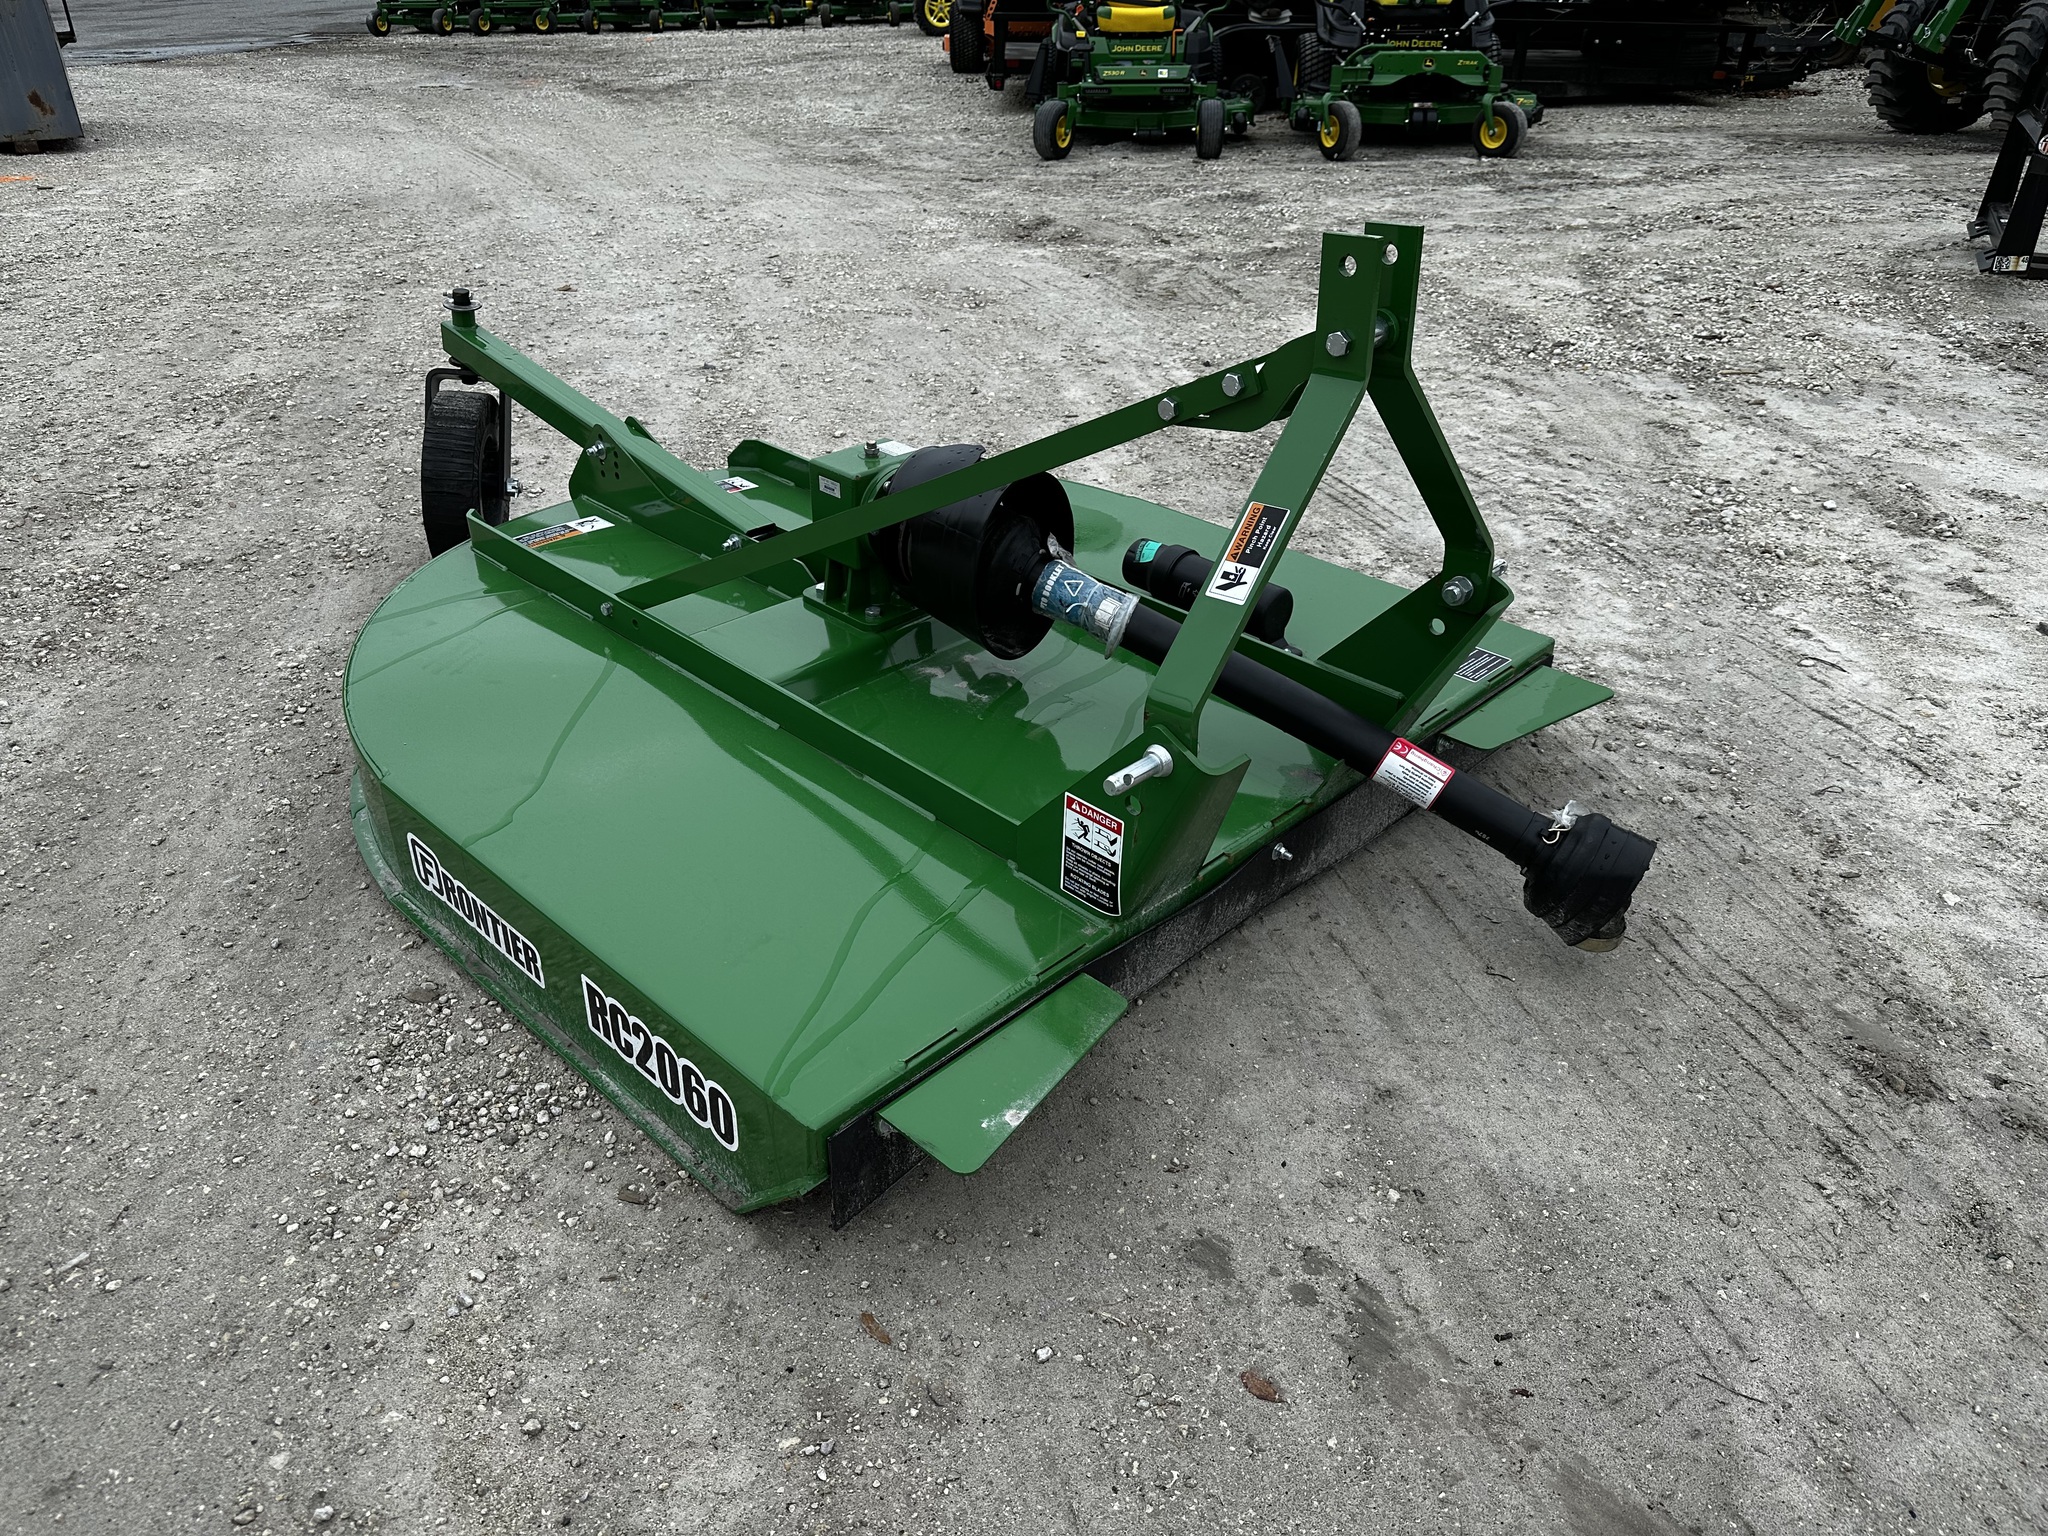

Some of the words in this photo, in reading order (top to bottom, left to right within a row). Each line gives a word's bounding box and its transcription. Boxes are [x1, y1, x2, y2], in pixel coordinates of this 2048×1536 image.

[1111, 44, 1134, 52] JOHN
[1135, 44, 1163, 52] DEERE
[1386, 39, 1409, 47] JOHN
[1411, 39, 1444, 48] DEERE
[1234, 507, 1261, 551] WARNING
[1245, 535, 1258, 554] Pinch
[1255, 517, 1268, 534] Point
[1256, 525, 1271, 547] Hazard
[1081, 805, 1118, 831] DANGER
[410, 837, 543, 984] FRONTIER
[586, 981, 736, 1145] RC2060
